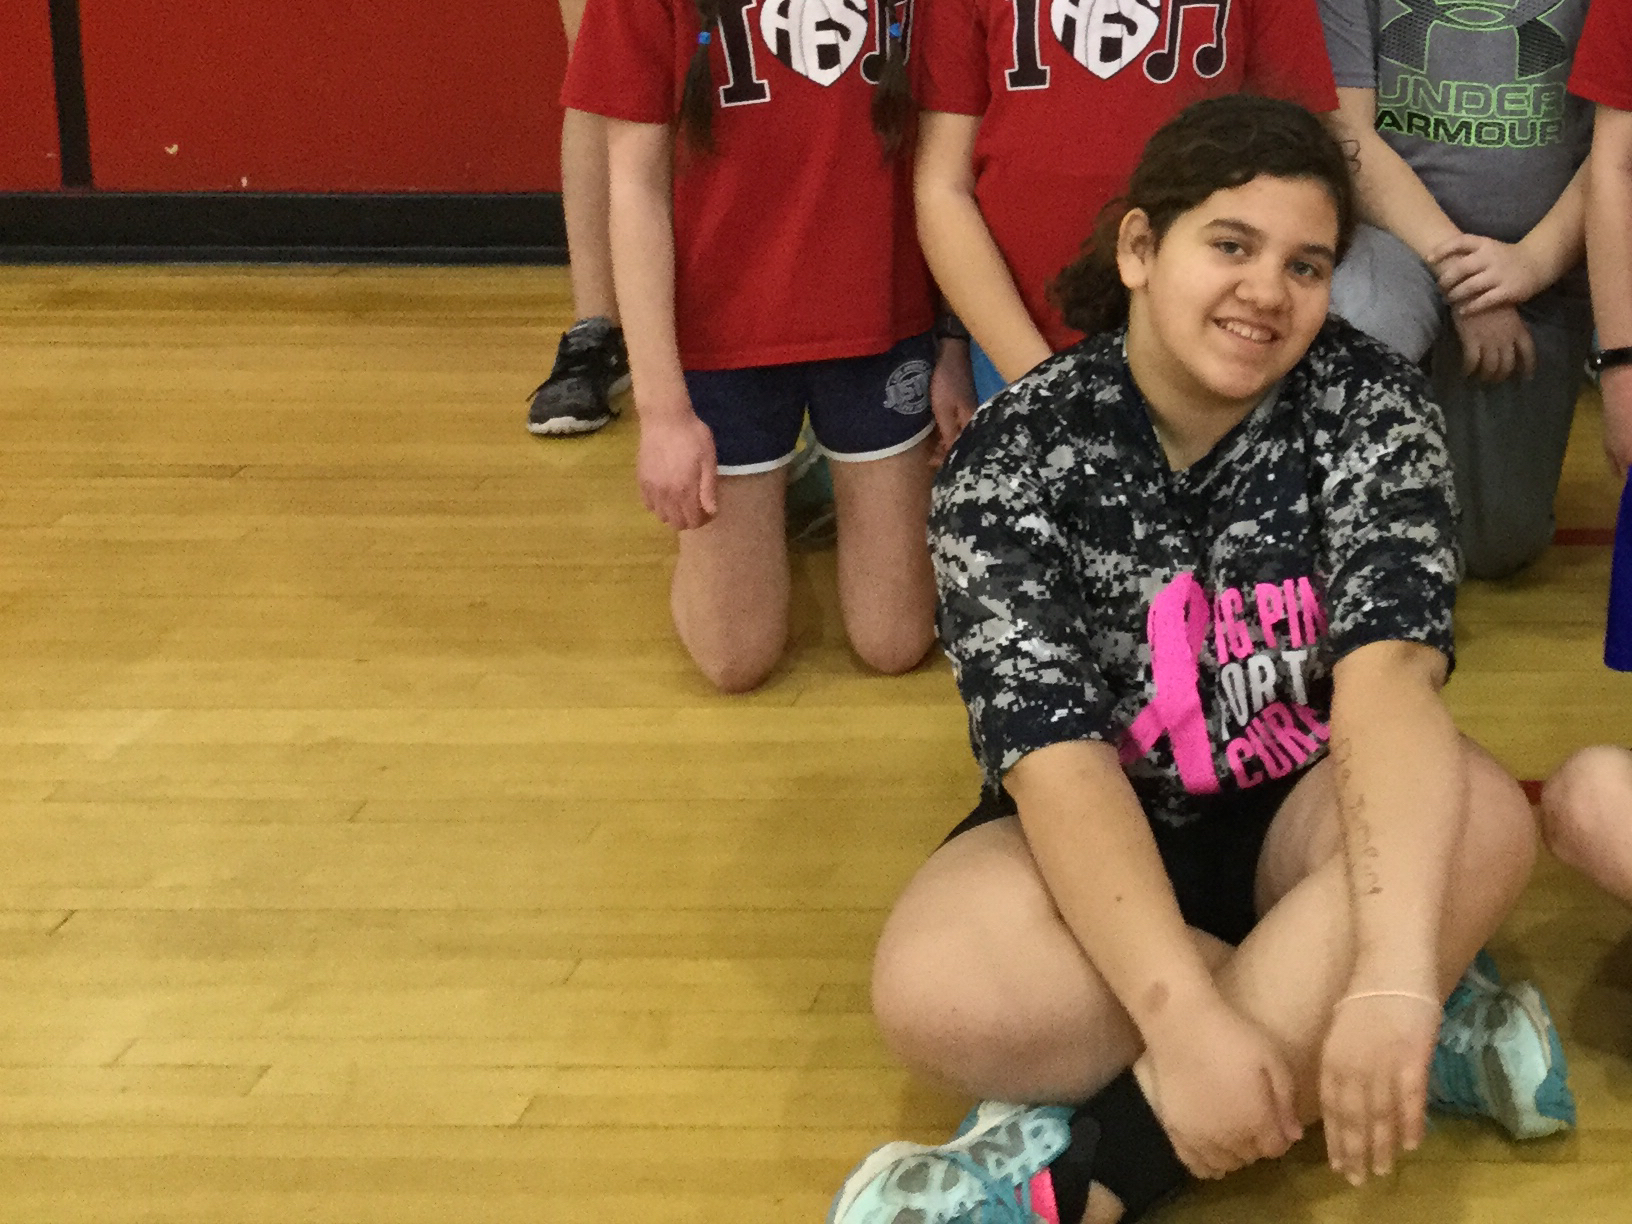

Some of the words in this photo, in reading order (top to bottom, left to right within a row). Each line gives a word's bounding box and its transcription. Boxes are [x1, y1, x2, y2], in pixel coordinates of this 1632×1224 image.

[1376, 74, 1567, 118] UNDER
[1374, 109, 1567, 149] ARMOUR
[1213, 587, 1255, 665] IG
[1254, 576, 1329, 650] PIN
